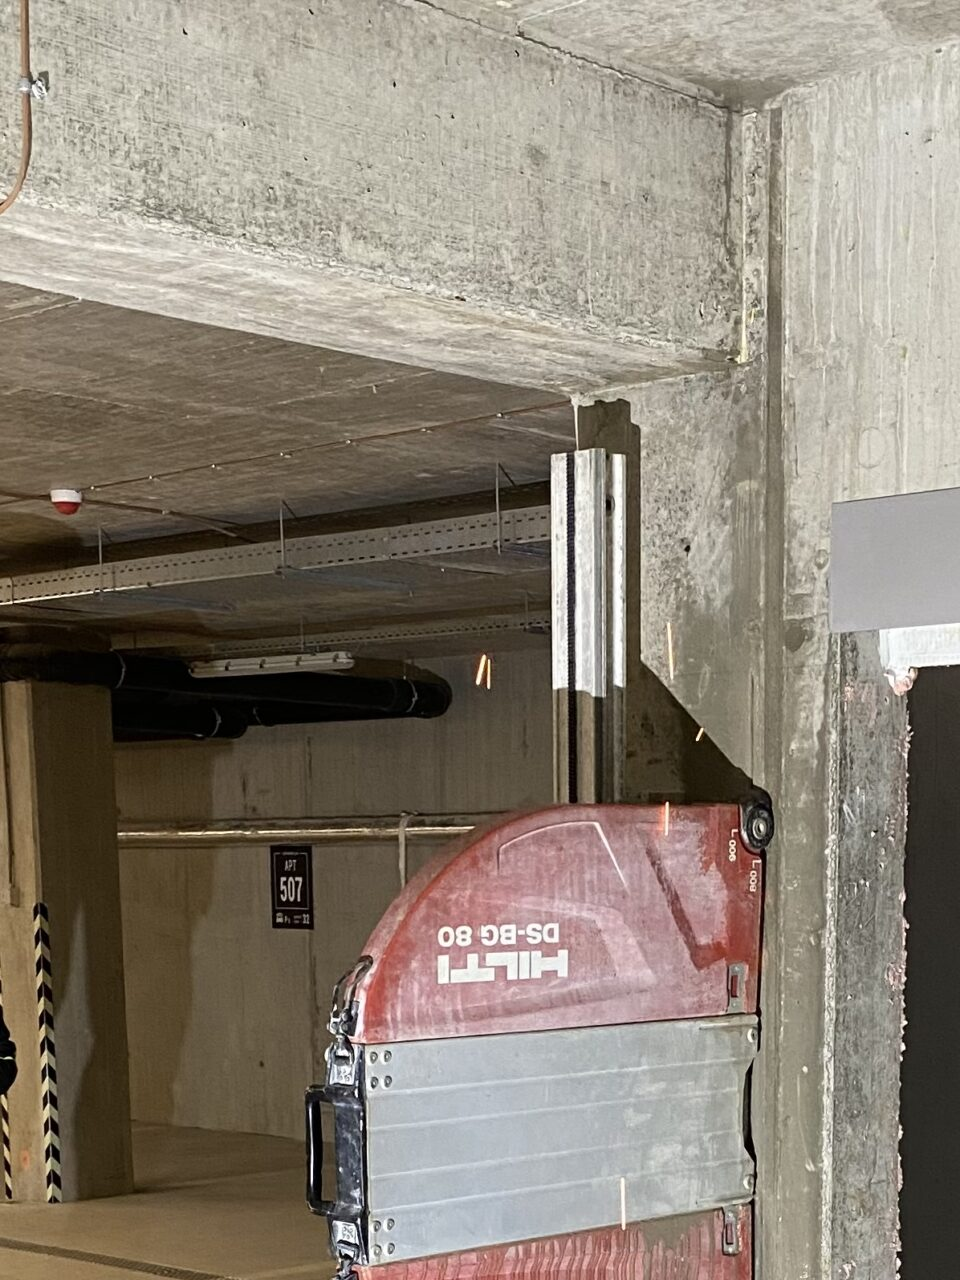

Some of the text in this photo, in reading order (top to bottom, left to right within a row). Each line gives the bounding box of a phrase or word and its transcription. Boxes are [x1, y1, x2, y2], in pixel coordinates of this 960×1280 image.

[284, 859, 297, 871] APT
[280, 877, 303, 902] 507
[437, 923, 560, 948] DS-BG 80
[437, 949, 569, 985] HILTI
